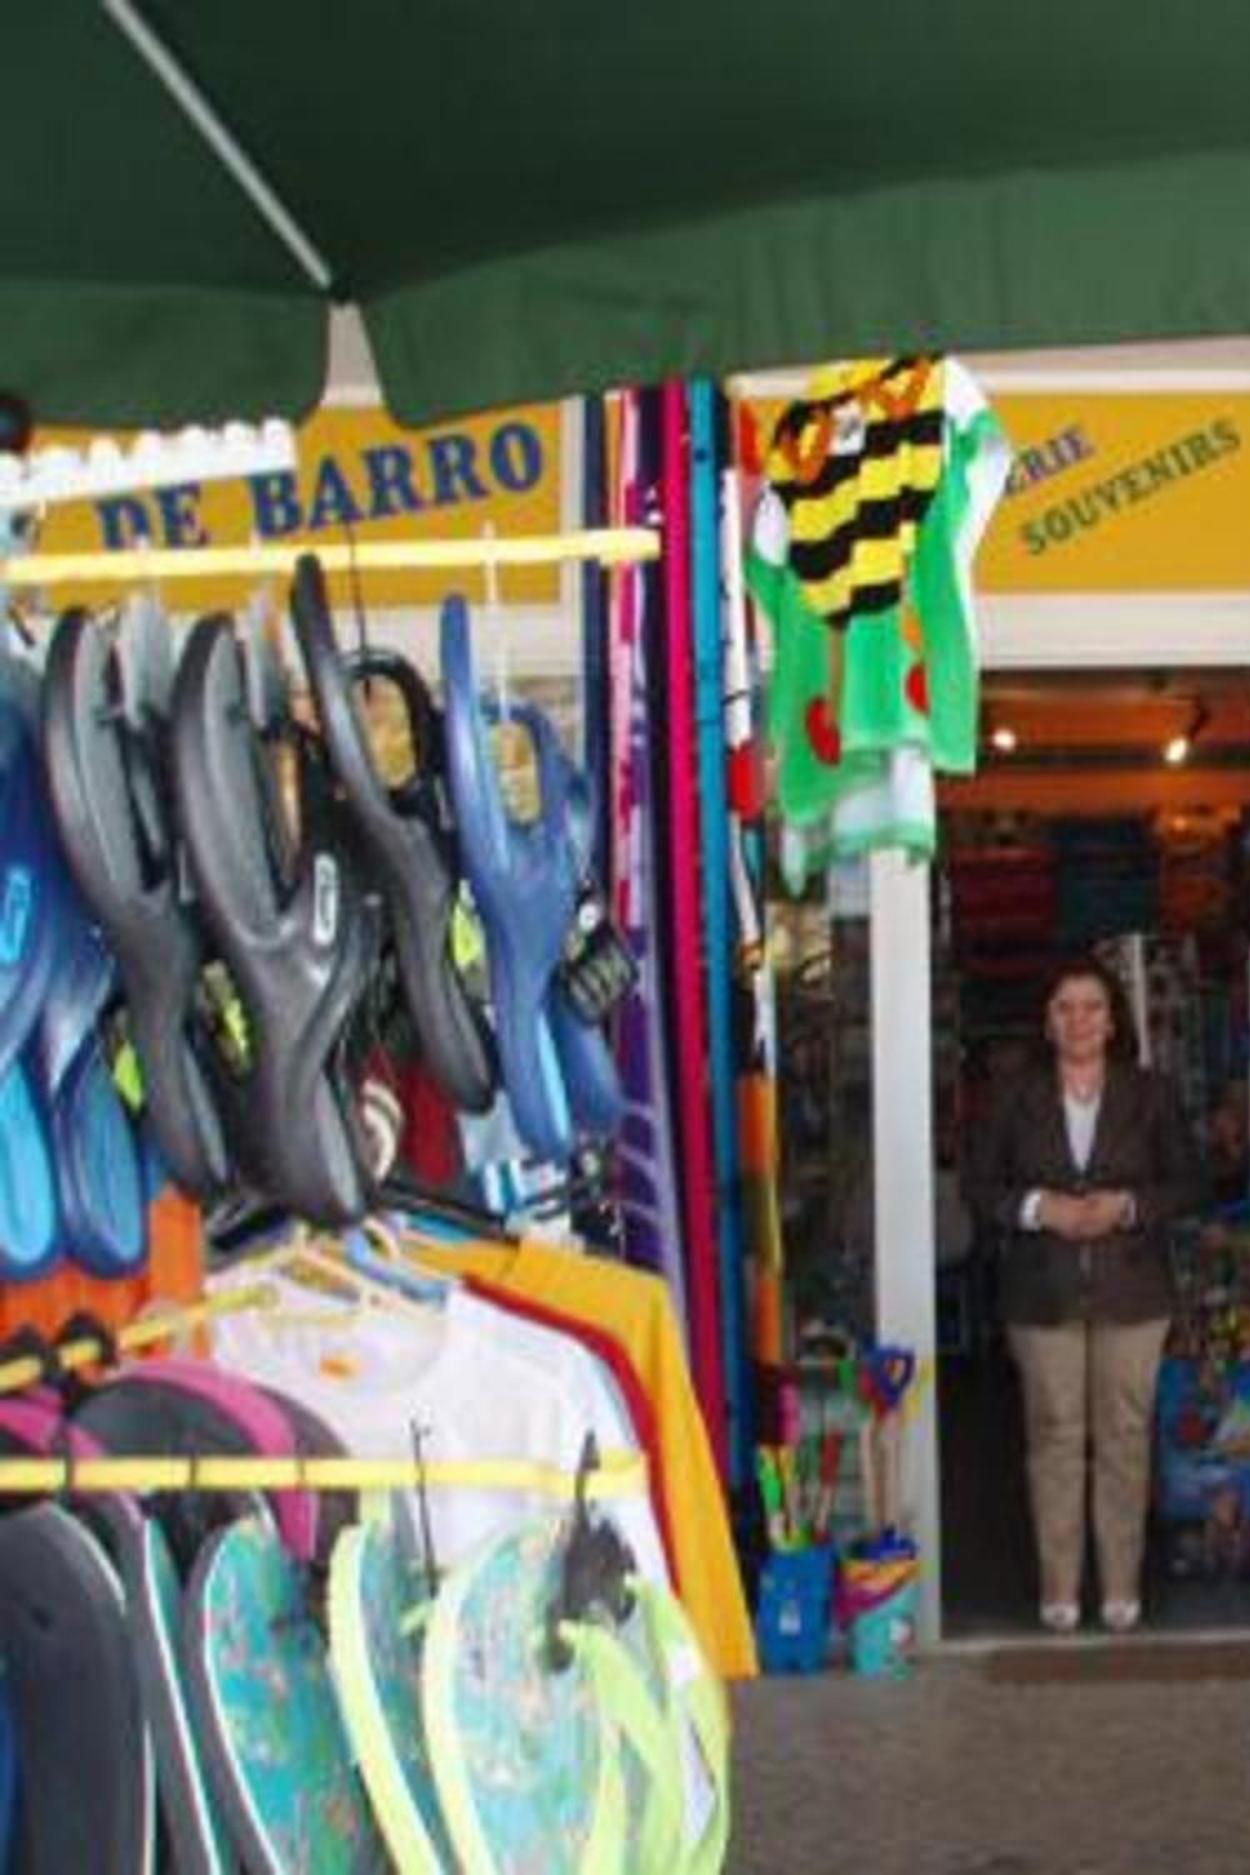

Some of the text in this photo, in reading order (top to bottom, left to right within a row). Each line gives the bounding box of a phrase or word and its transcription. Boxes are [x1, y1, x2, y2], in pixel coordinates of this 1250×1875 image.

[96, 422, 543, 551] DE BARRO
[1020, 418, 1241, 556] SOUVENIRS
